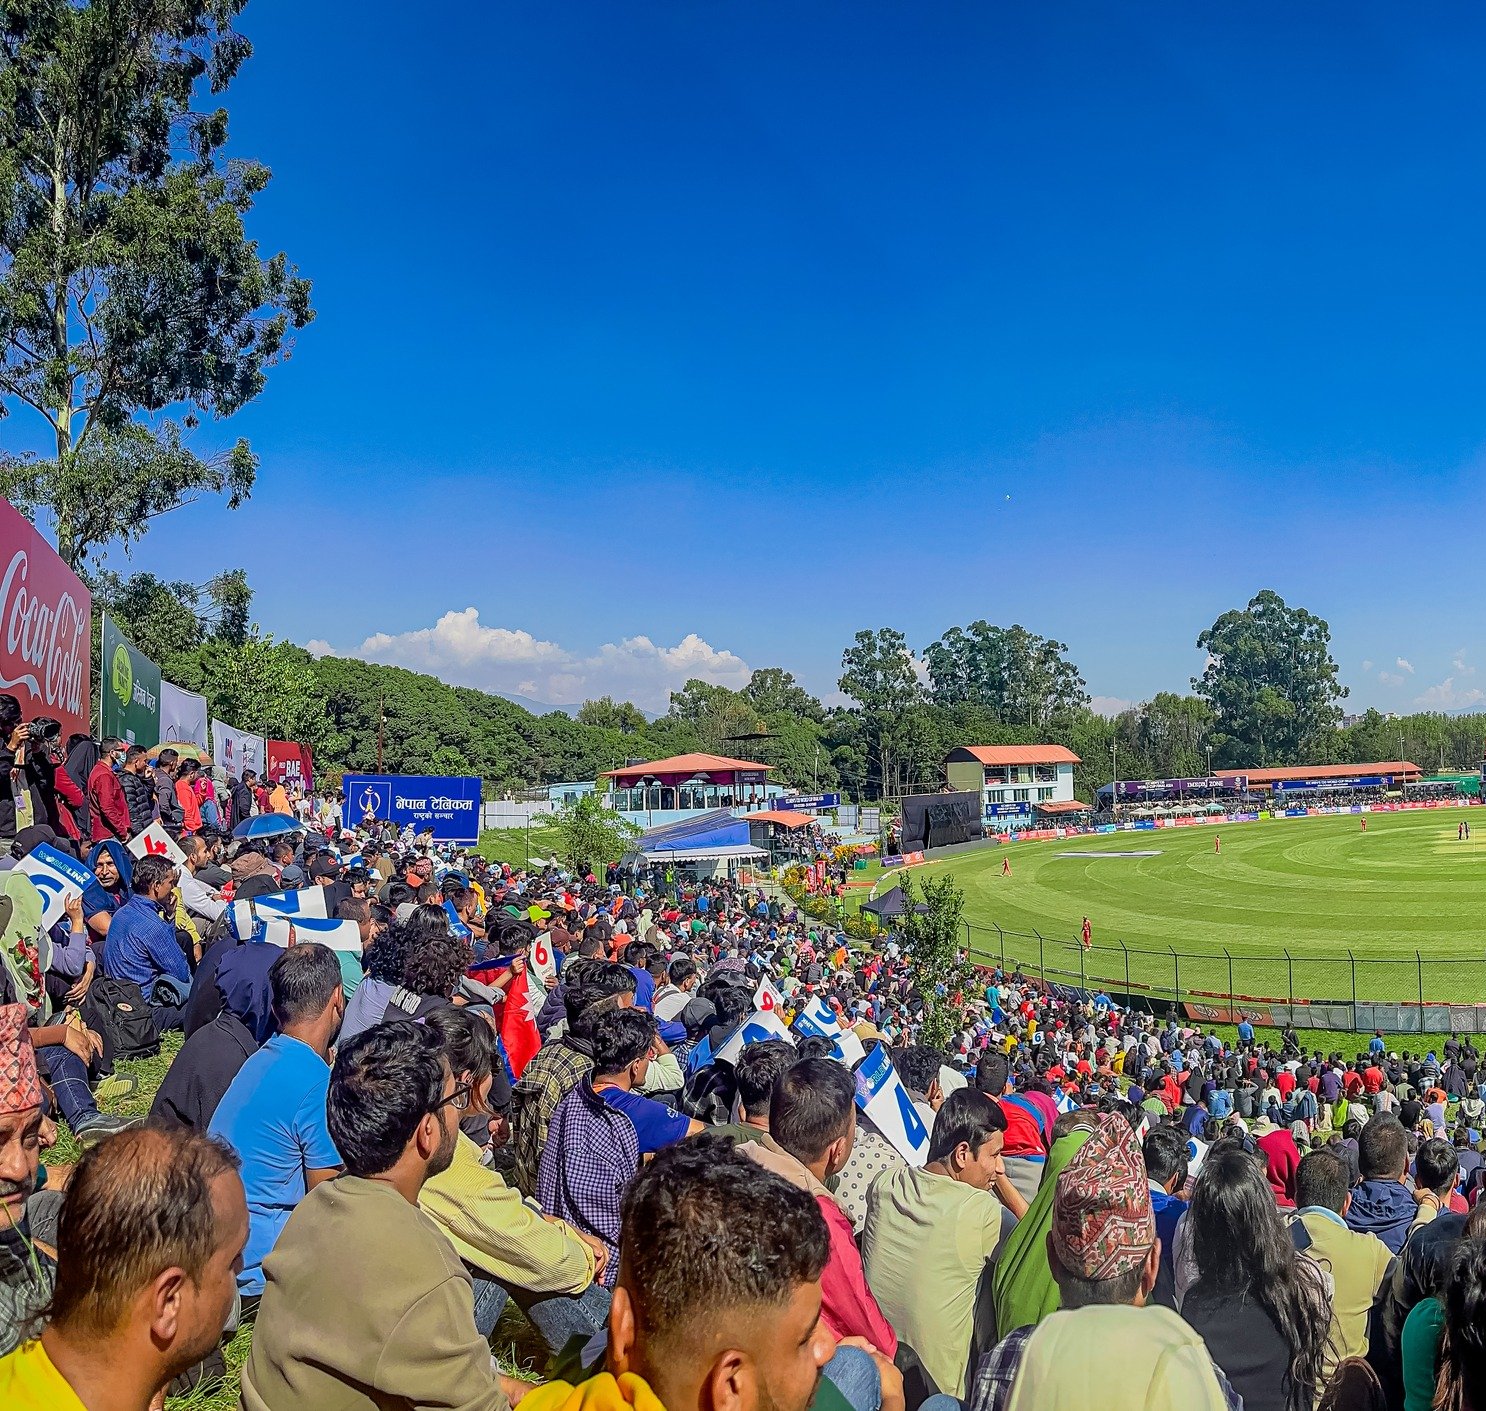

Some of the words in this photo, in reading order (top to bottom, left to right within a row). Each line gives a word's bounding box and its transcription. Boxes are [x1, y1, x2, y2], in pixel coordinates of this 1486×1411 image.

[0, 550, 86, 716] Coca-Cola
[395, 795, 427, 810] नेपाल
[429, 795, 474, 811] टेलिकम
[535, 939, 548, 966] 6
